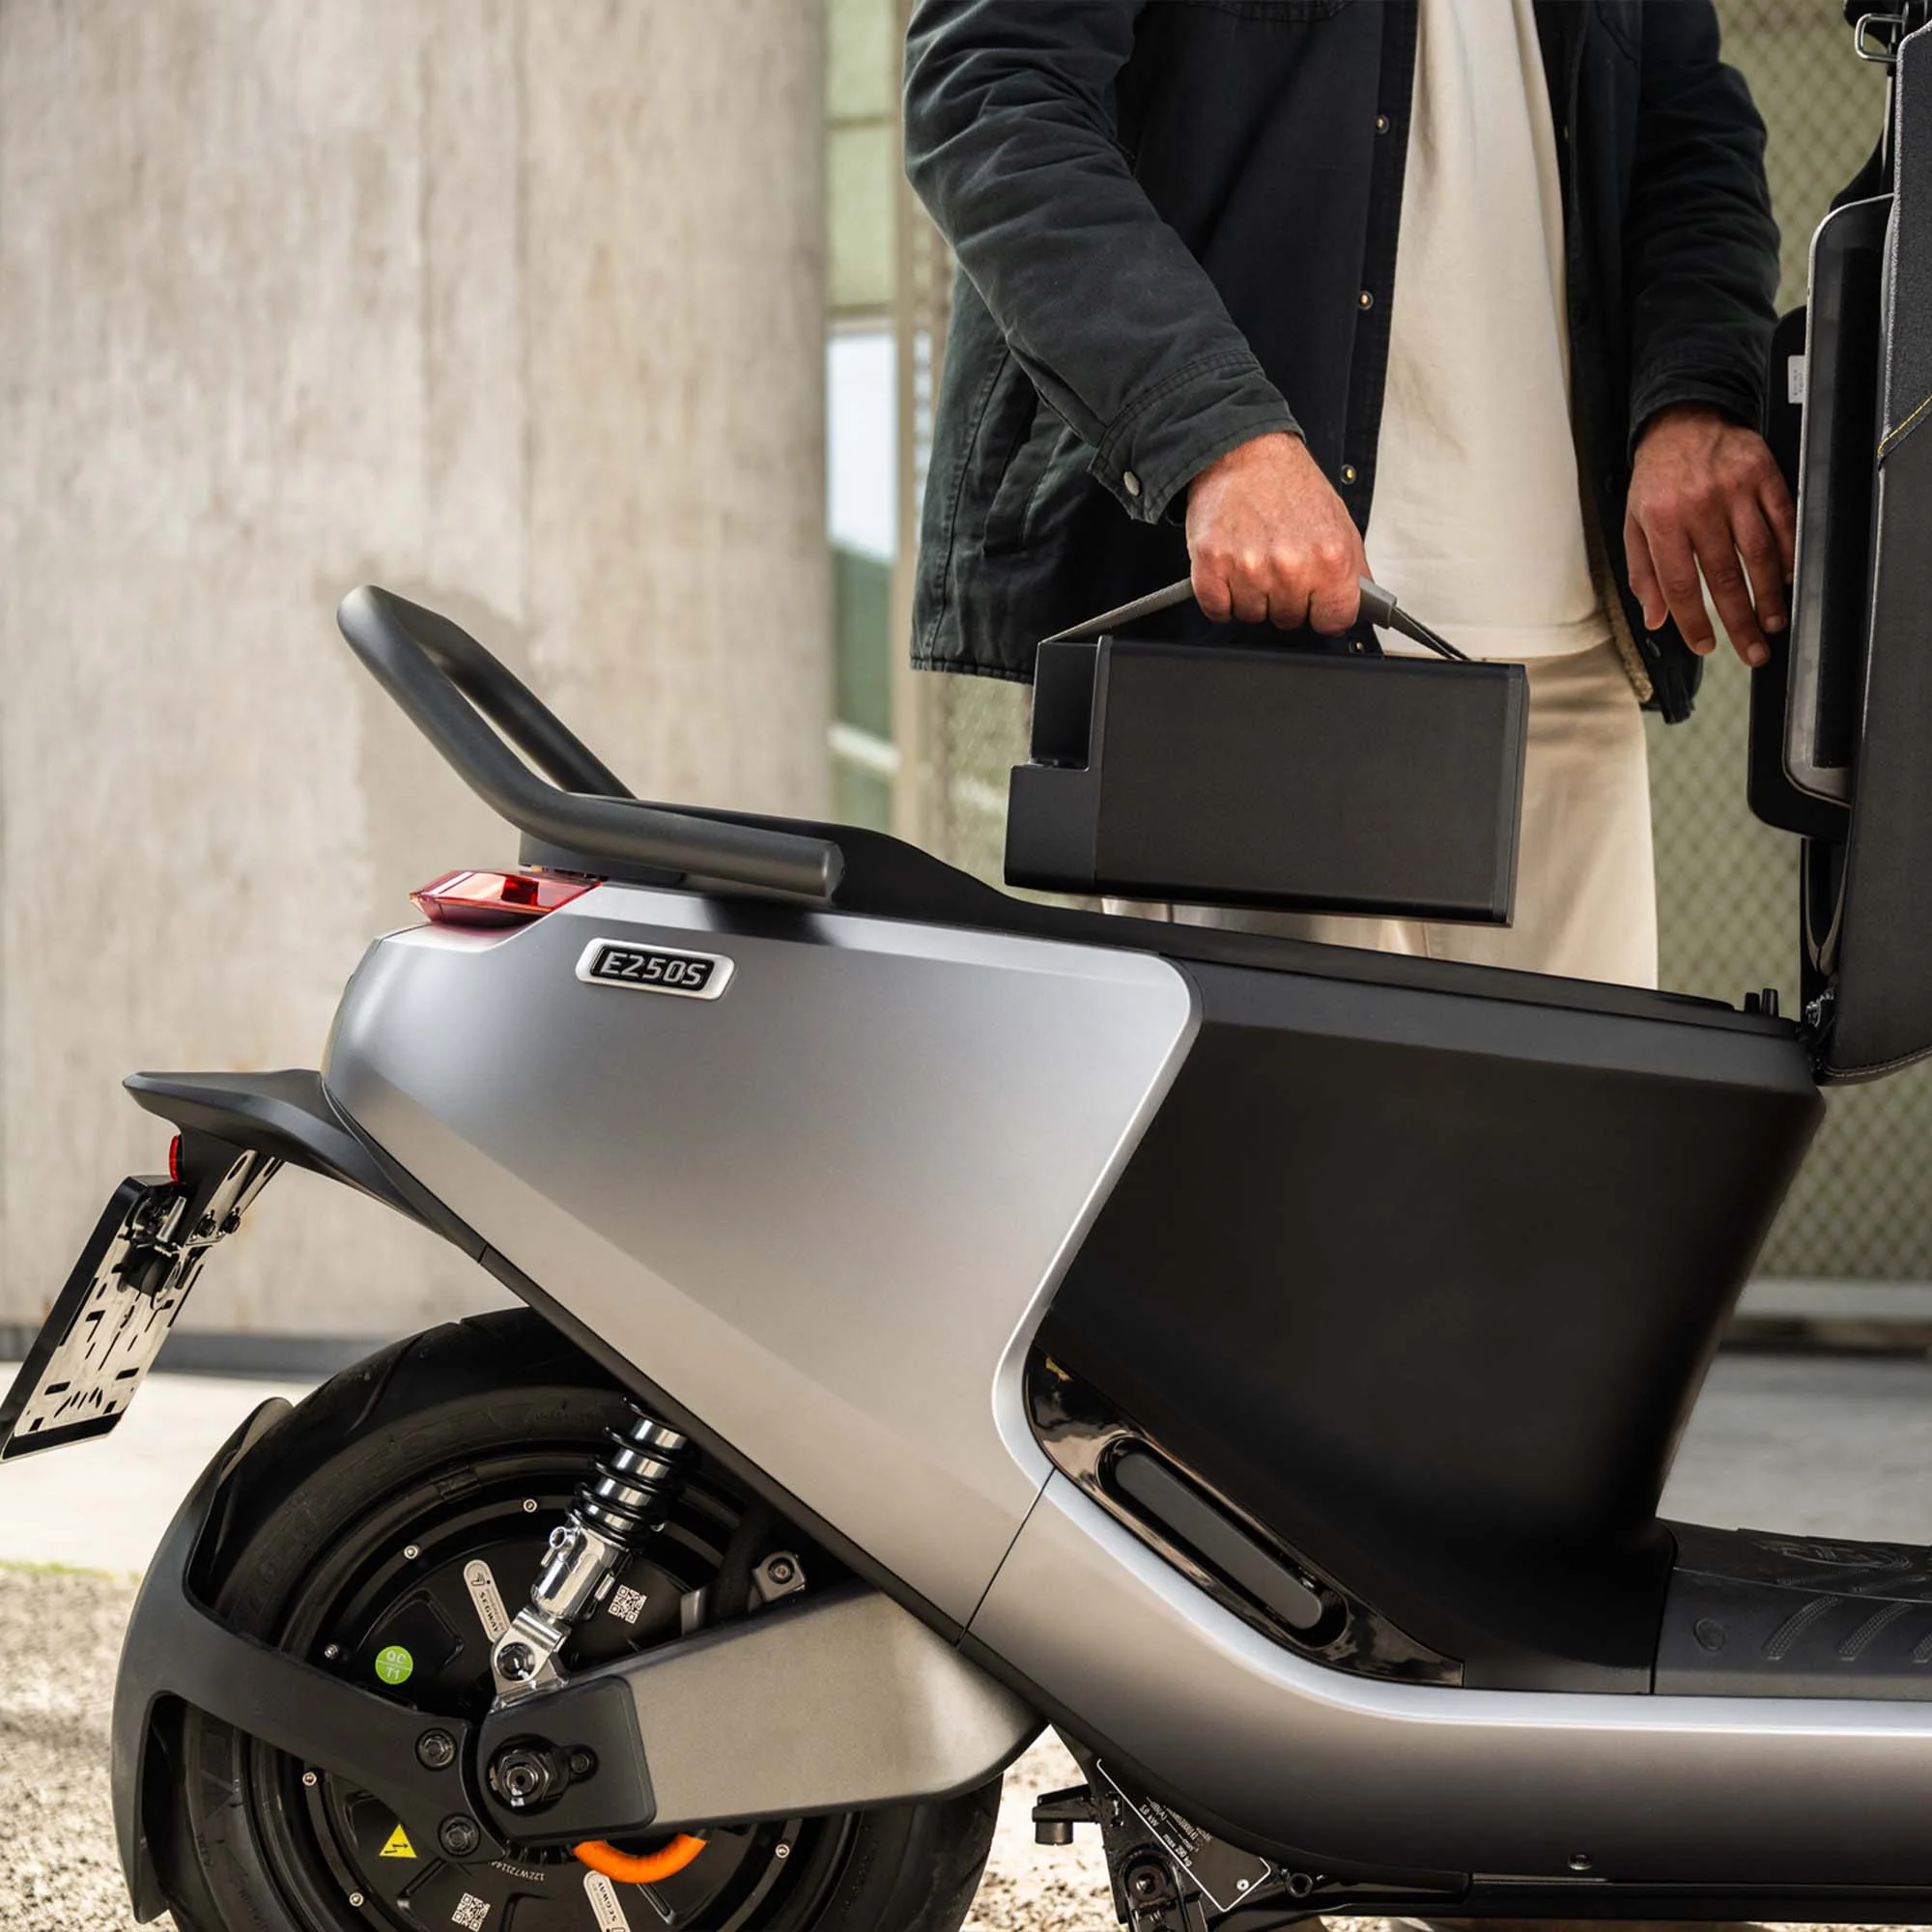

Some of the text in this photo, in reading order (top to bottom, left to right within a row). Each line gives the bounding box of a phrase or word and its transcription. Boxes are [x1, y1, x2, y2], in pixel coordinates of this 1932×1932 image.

[600, 951, 707, 986] E250S
[479, 1591, 499, 1633] SEGWAY
[597, 1881, 617, 1922] SEGWAY
